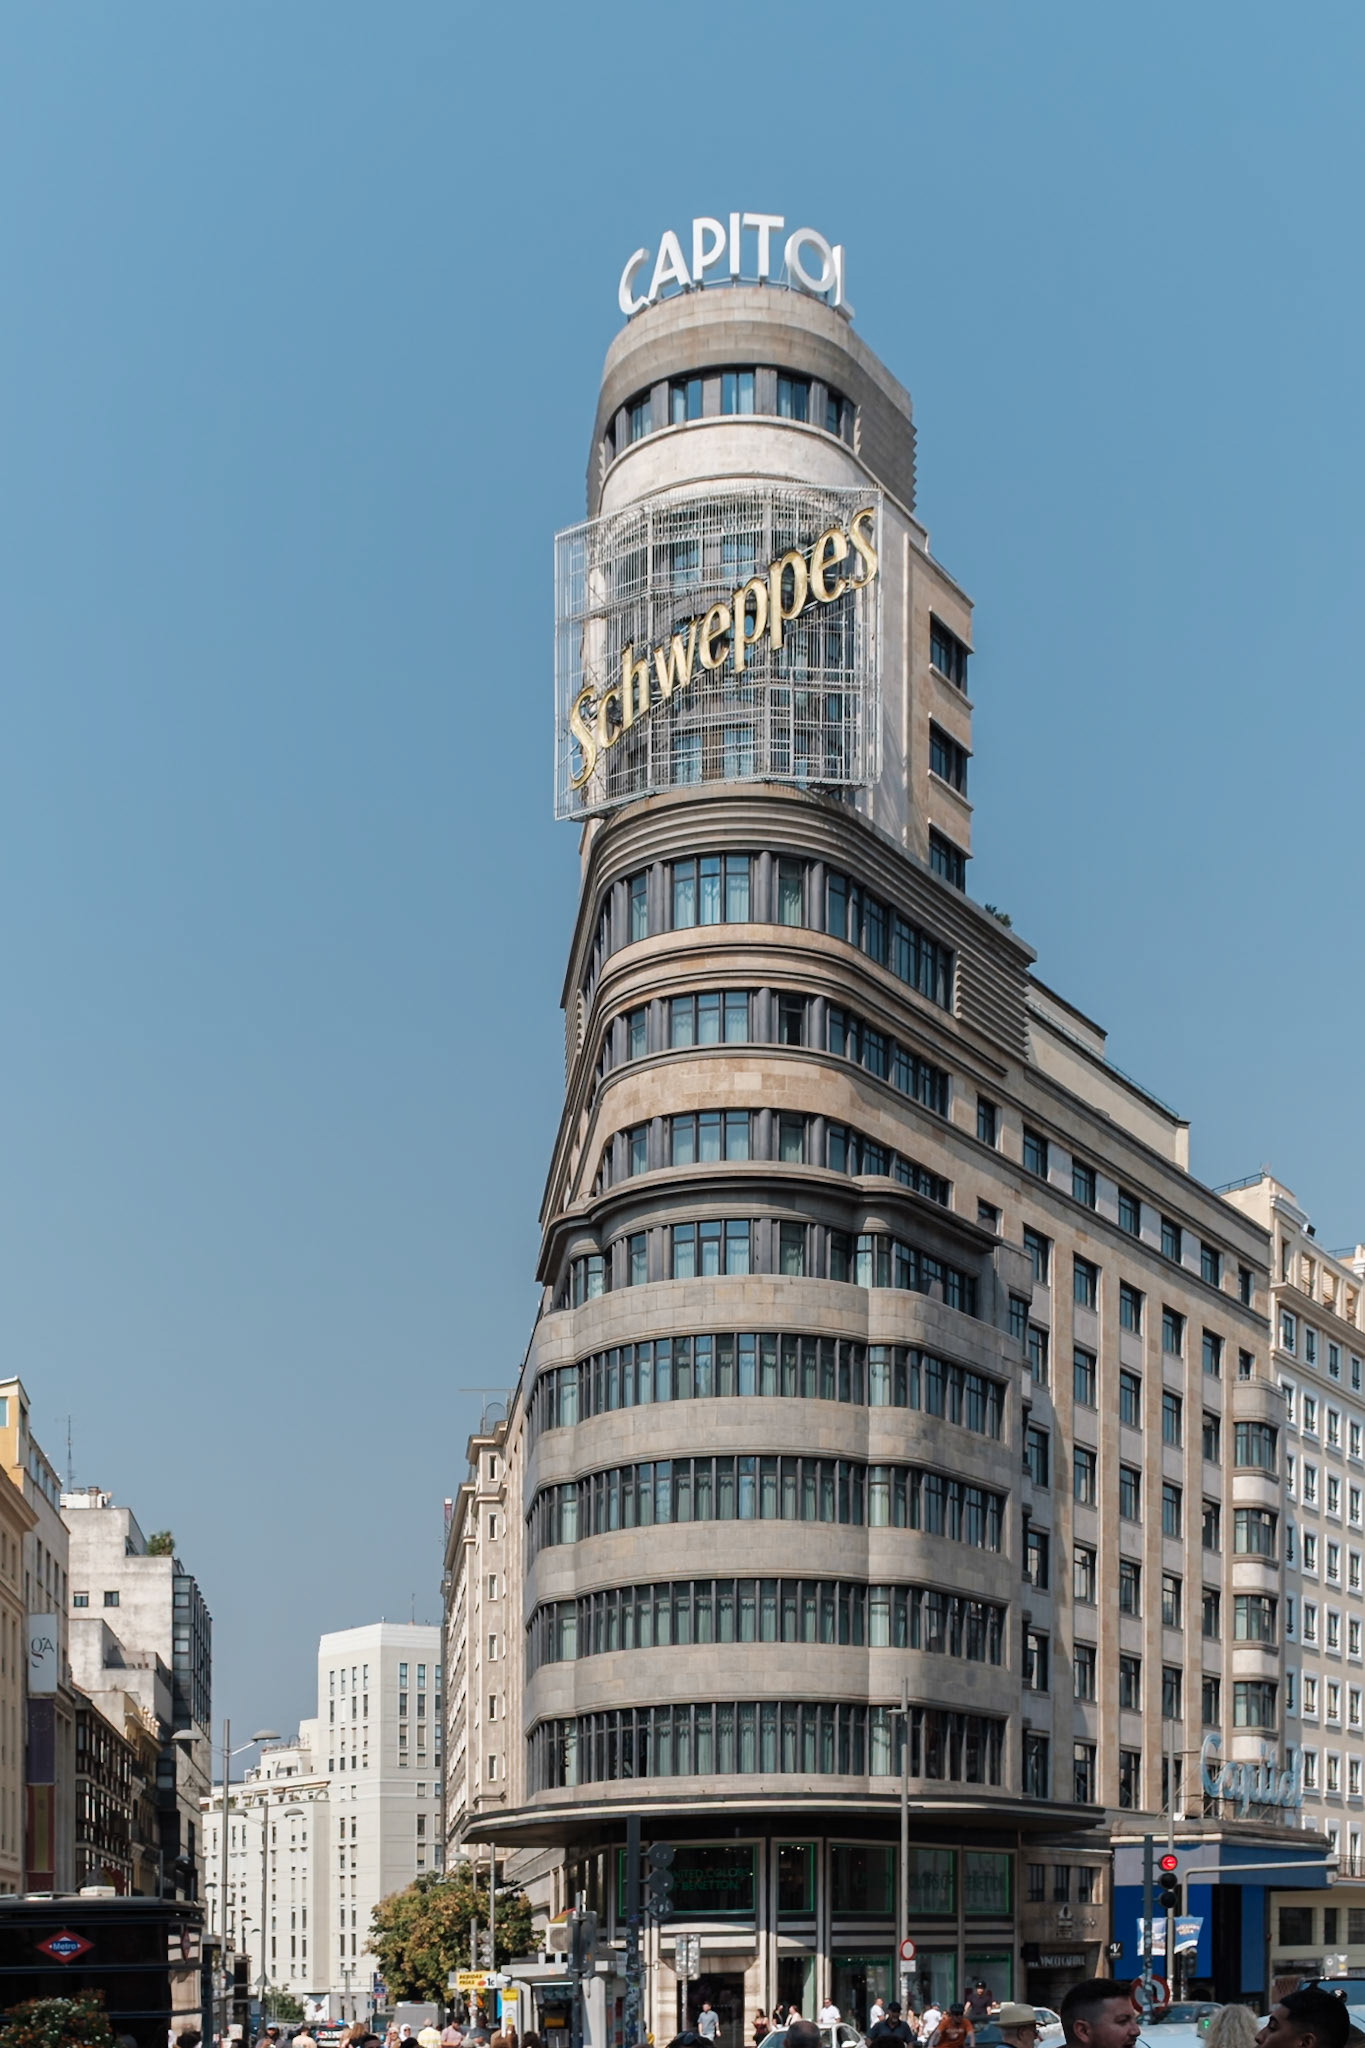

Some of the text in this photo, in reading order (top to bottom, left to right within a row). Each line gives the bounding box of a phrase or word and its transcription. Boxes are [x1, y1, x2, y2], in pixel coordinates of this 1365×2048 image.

[618, 212, 856, 320] CAPITOL
[569, 507, 879, 791] Schweppes
[1201, 1734, 1304, 1817] Capitol
[672, 1867, 704, 1879] NITED
[52, 1942, 77, 1950] Metro
